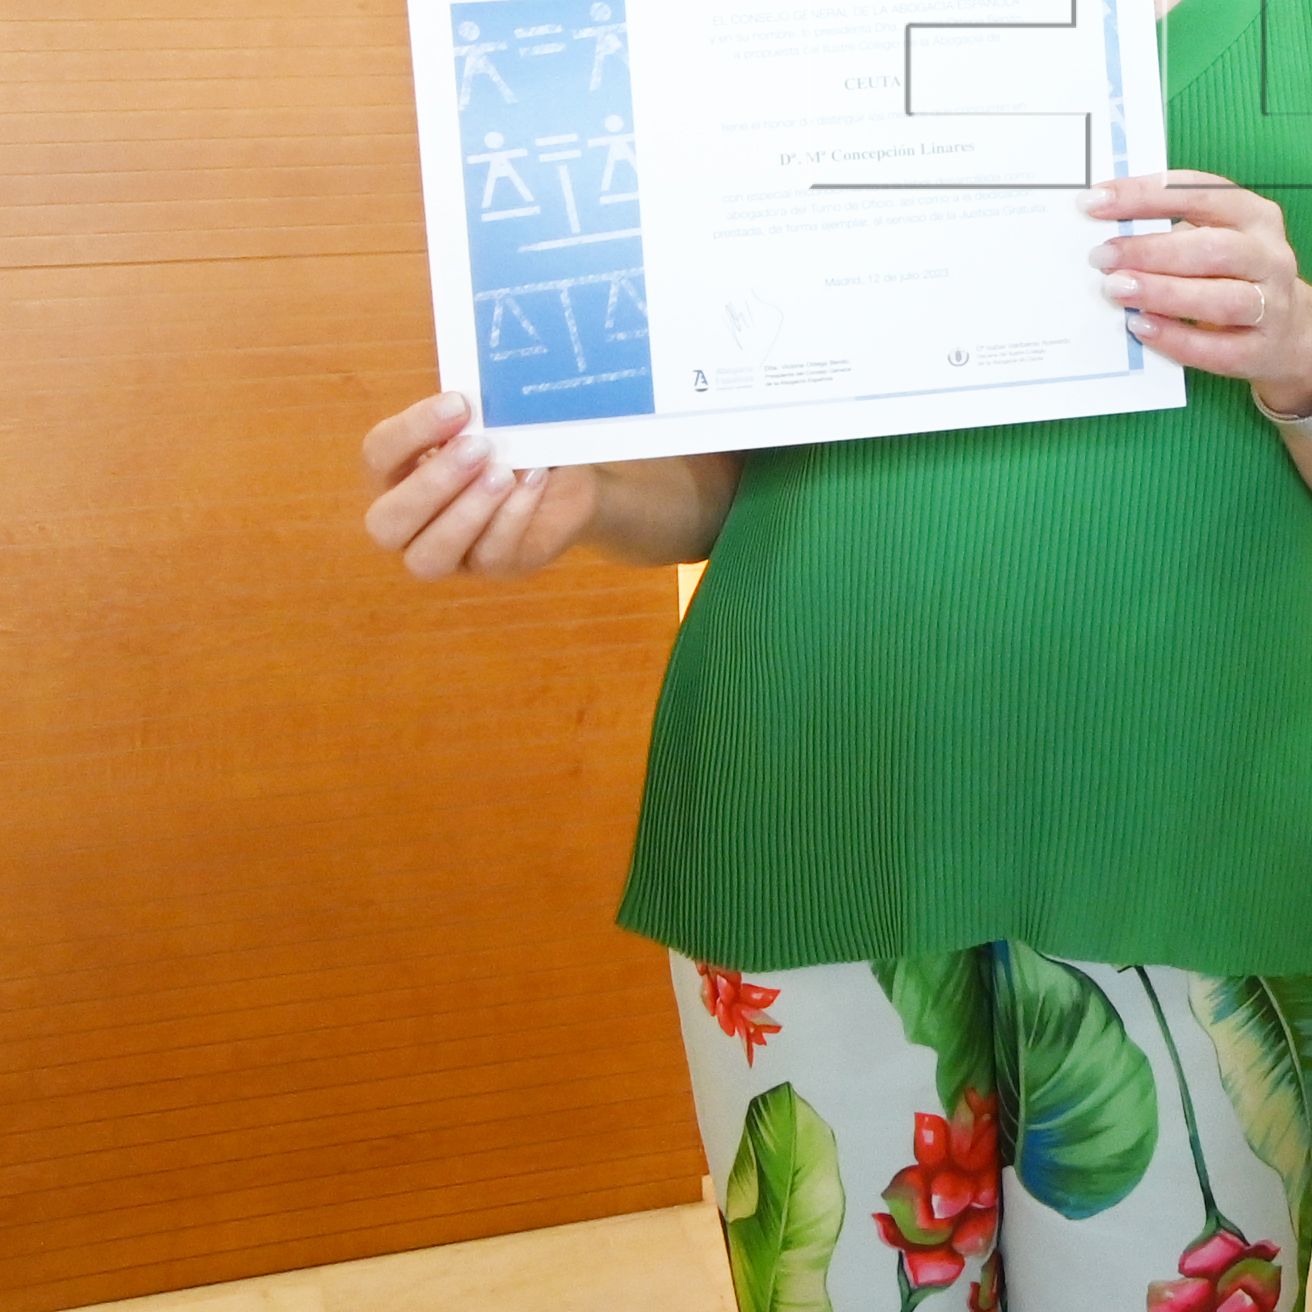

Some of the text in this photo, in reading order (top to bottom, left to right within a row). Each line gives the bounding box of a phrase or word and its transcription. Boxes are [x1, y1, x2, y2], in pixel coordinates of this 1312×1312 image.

[843, 74, 904, 92] CEUTA
[830, 144, 916, 163] Concepción
[919, 141, 976, 157] Linares
